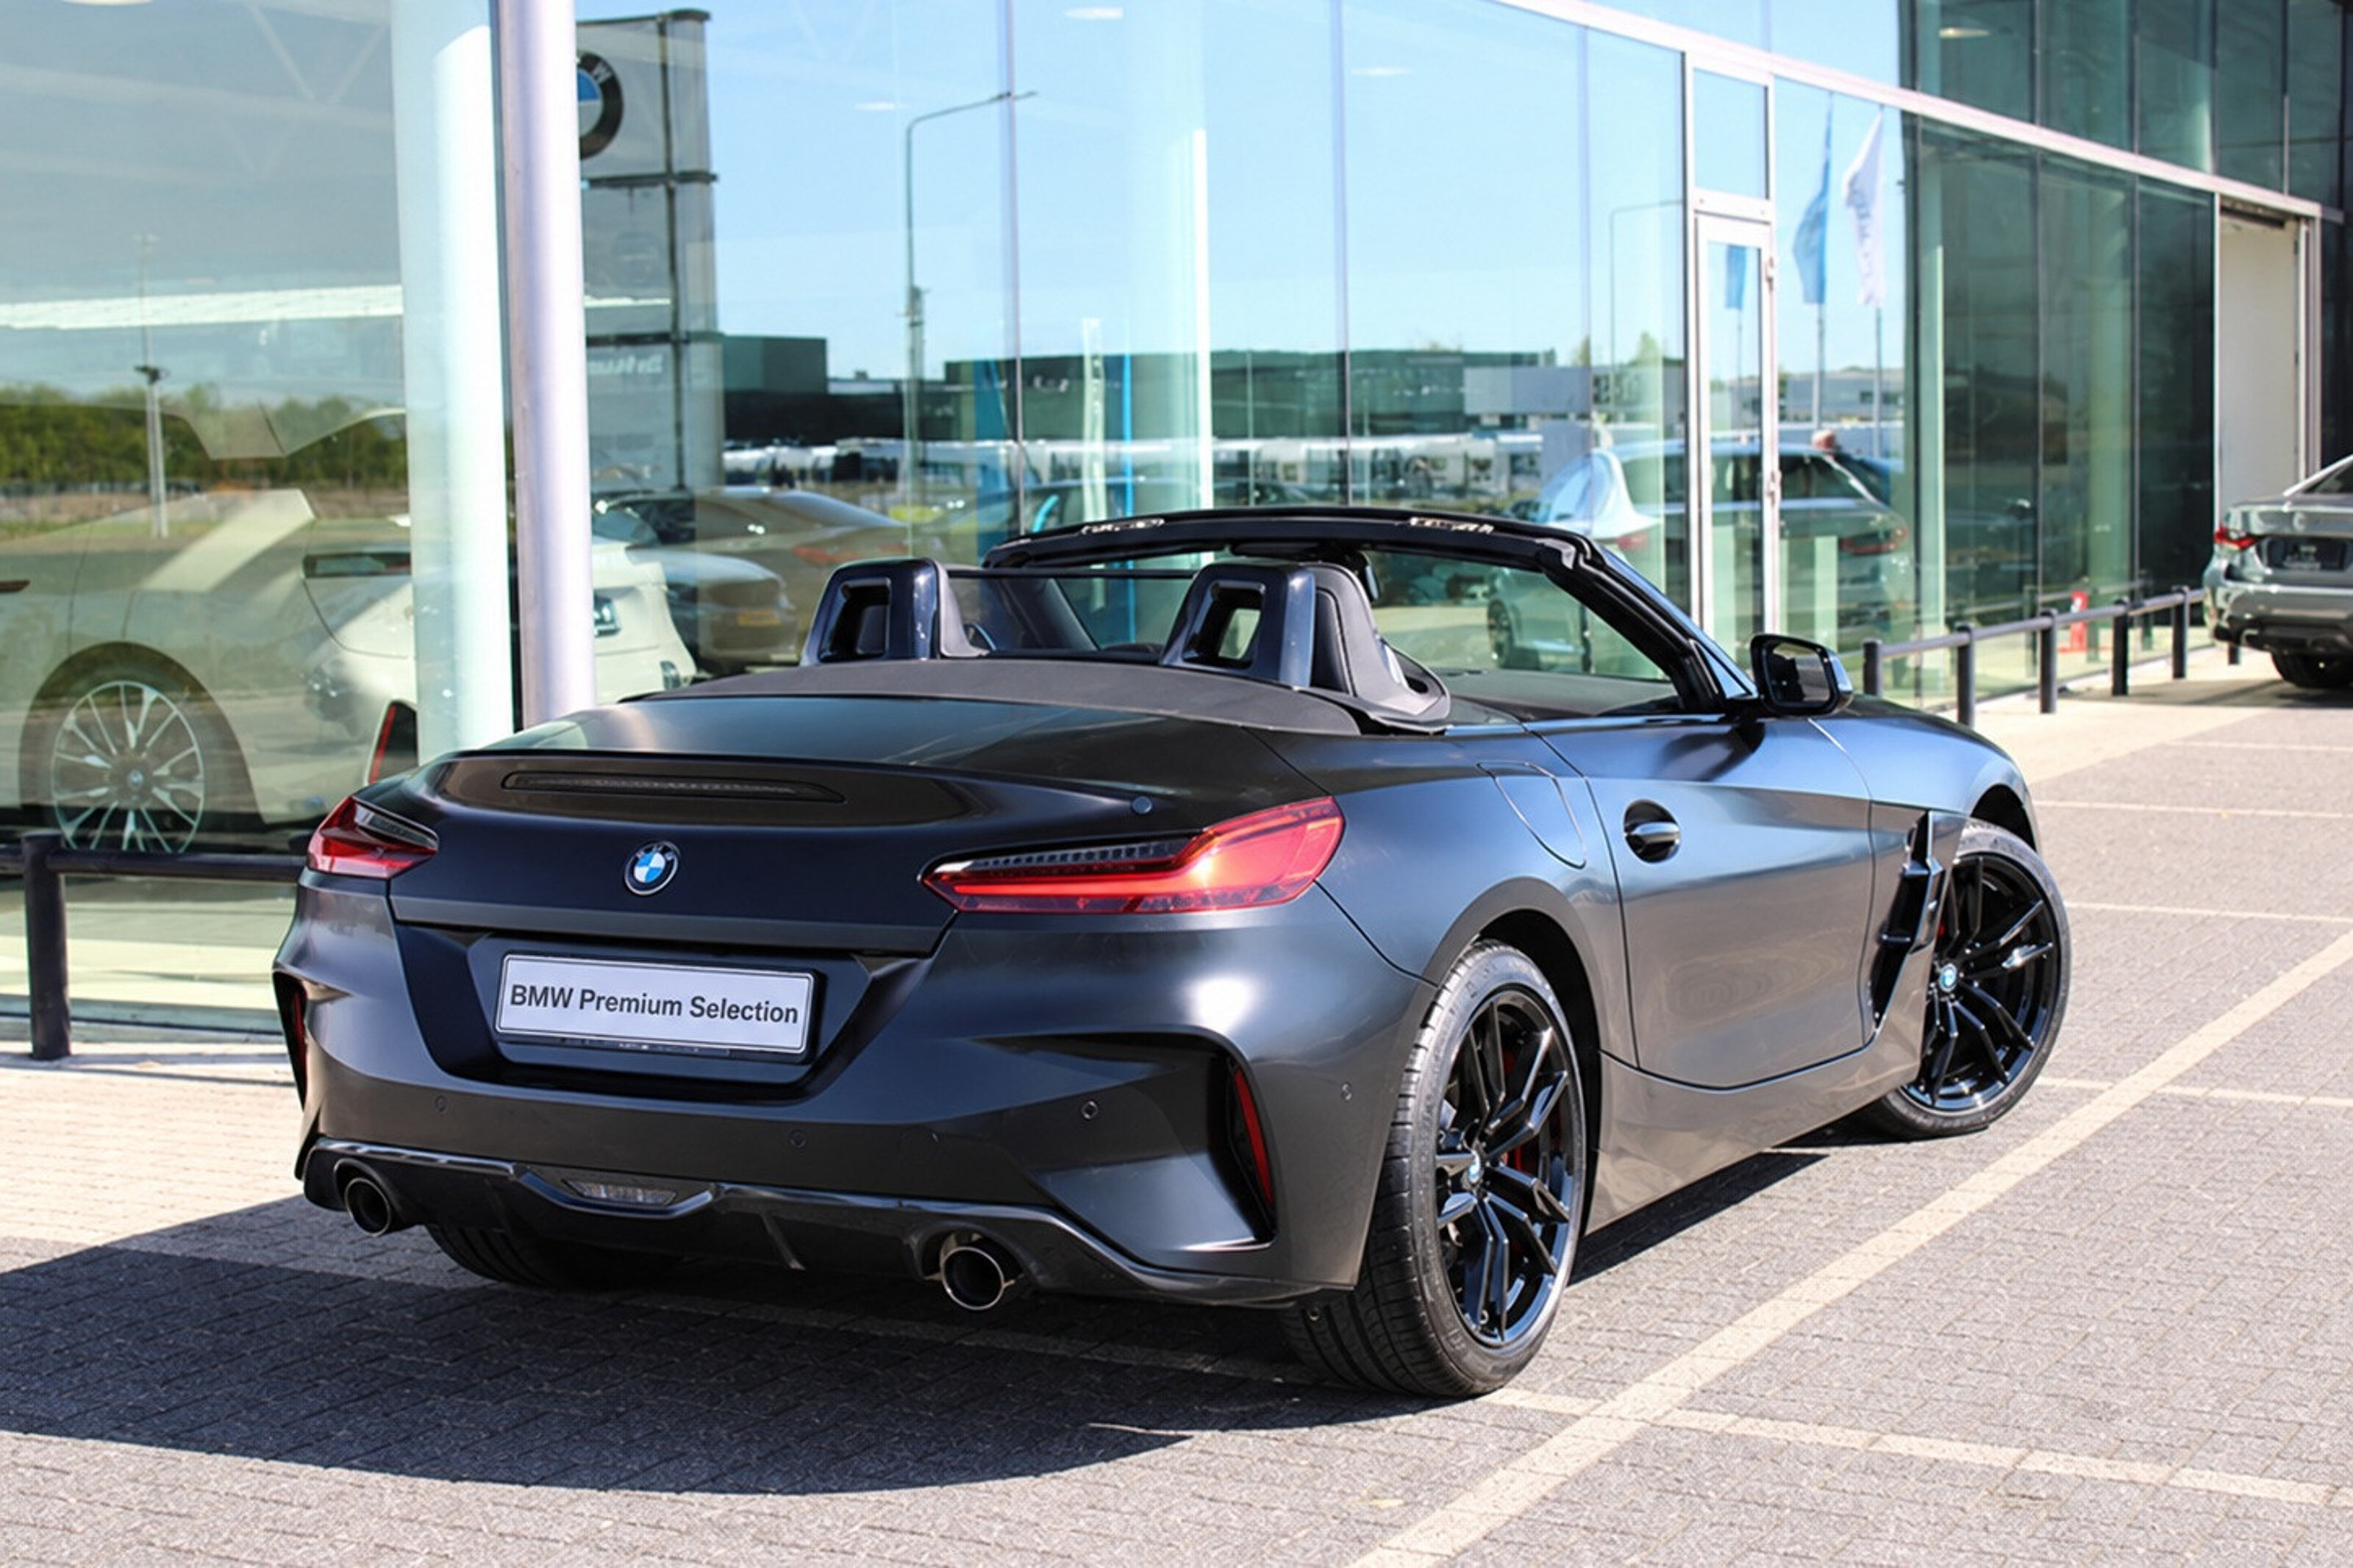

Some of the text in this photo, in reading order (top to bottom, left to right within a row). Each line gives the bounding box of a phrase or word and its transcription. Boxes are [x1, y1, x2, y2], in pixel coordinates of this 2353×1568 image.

[510, 984, 798, 1023] BMW Premium Selection
